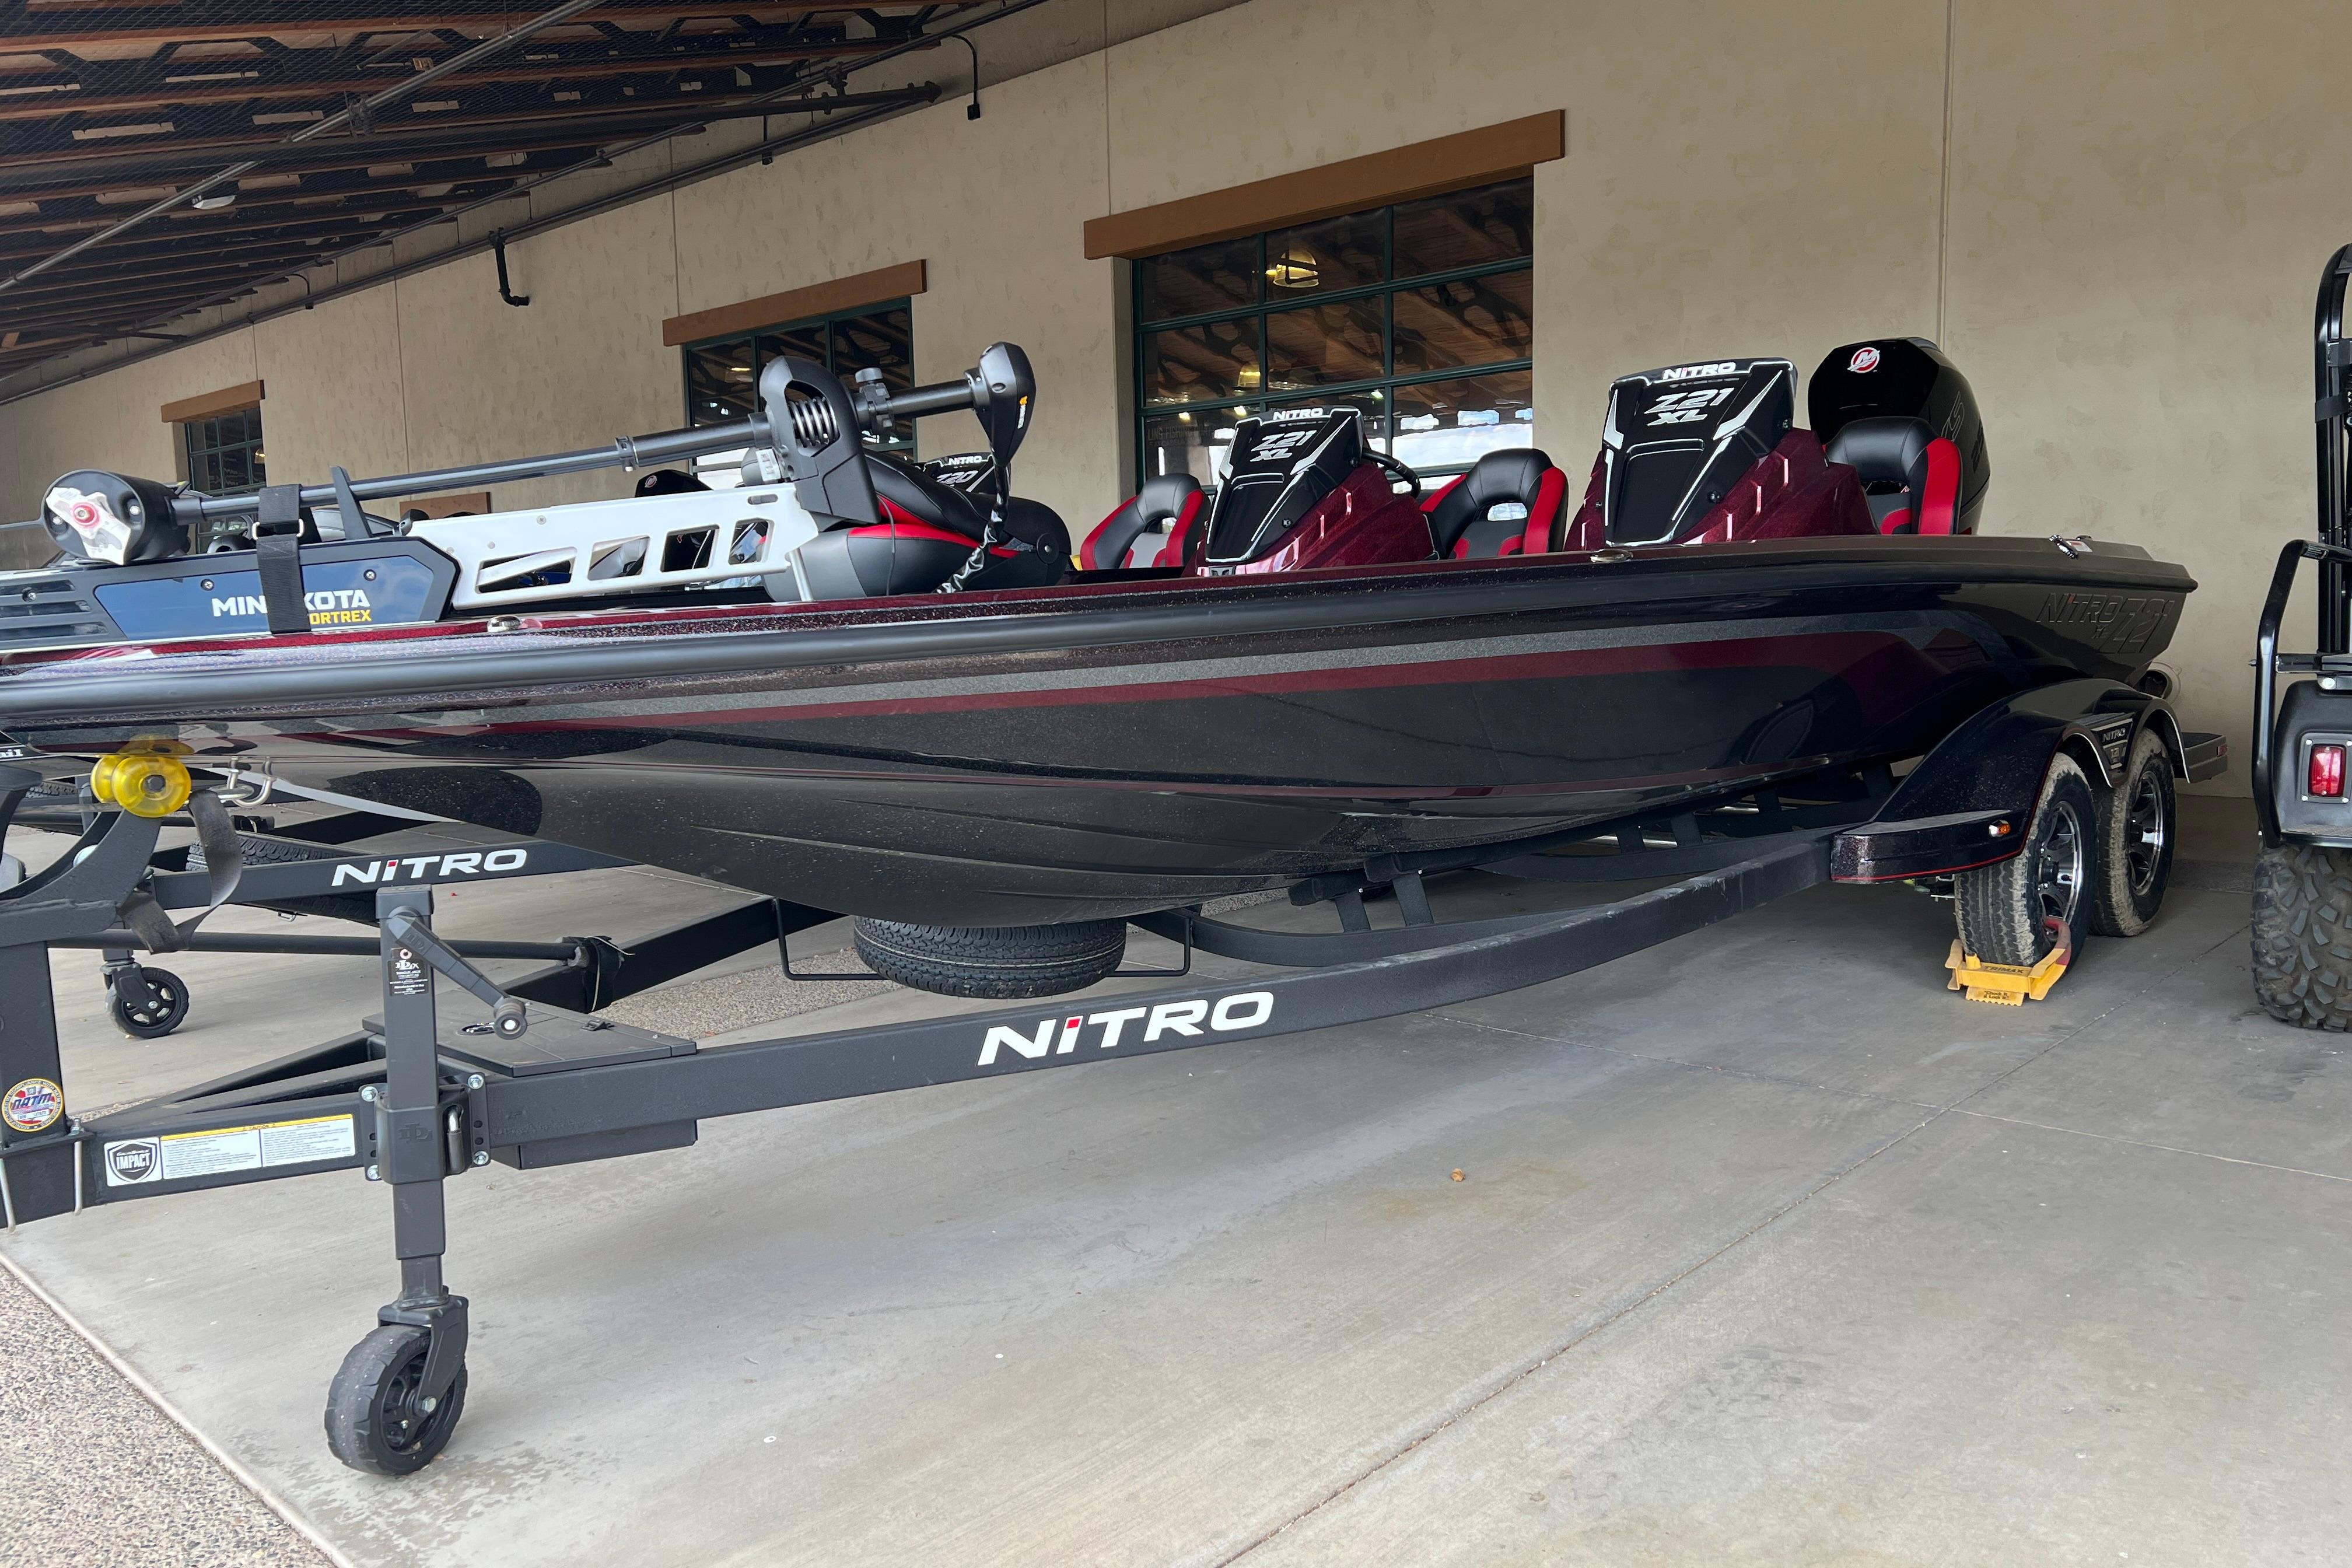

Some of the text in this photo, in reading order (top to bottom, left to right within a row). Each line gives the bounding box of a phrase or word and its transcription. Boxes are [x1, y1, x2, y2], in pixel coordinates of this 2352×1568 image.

[1644, 387, 1735, 414] Z21
[1647, 409, 1708, 426] XL
[1251, 429, 1317, 452] Z21
[1250, 447, 1293, 462] XL
[936, 470, 979, 484] Z20
[212, 594, 268, 617] MIN
[309, 609, 372, 625] ORTREX
[116, 1153, 151, 1170] IMPACT
